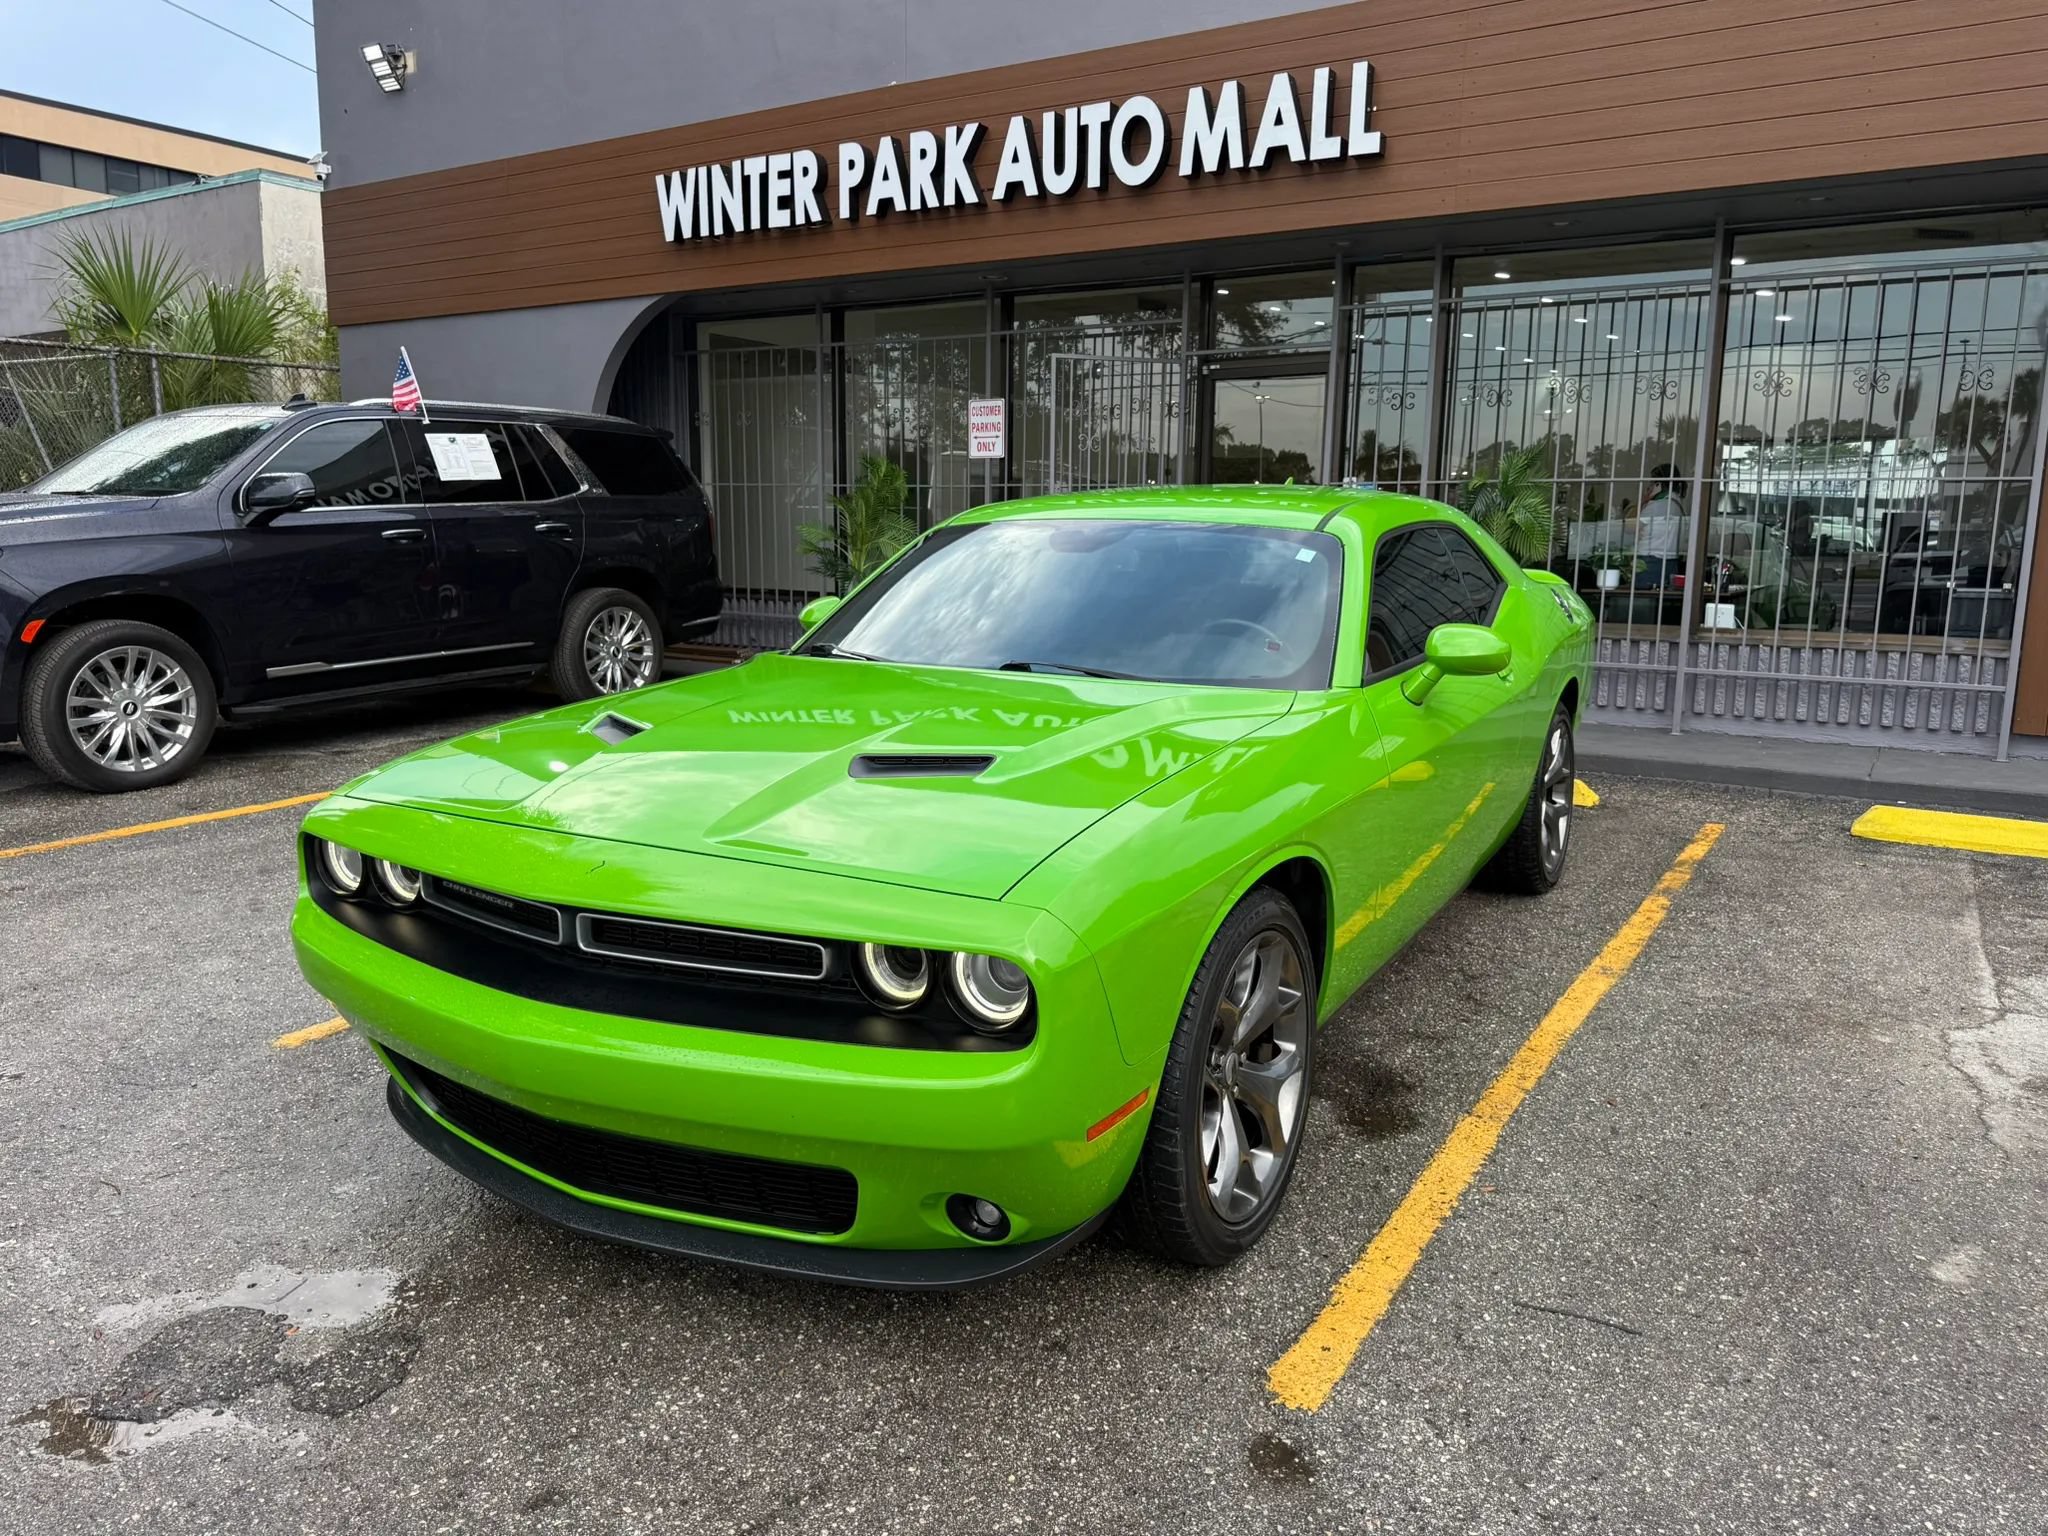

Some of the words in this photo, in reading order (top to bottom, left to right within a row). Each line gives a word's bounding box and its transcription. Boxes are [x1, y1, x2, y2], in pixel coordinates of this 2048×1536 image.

[655, 149, 823, 243] WINTER
[837, 121, 983, 220] PARK
[994, 95, 1160, 202] AUTO
[1178, 60, 1384, 177] MALL
[971, 405, 1002, 417] CUSTOMER
[971, 421, 1002, 433] PARKING
[977, 441, 996, 453] ONLY
[442, 880, 514, 908] CHALLENGER
